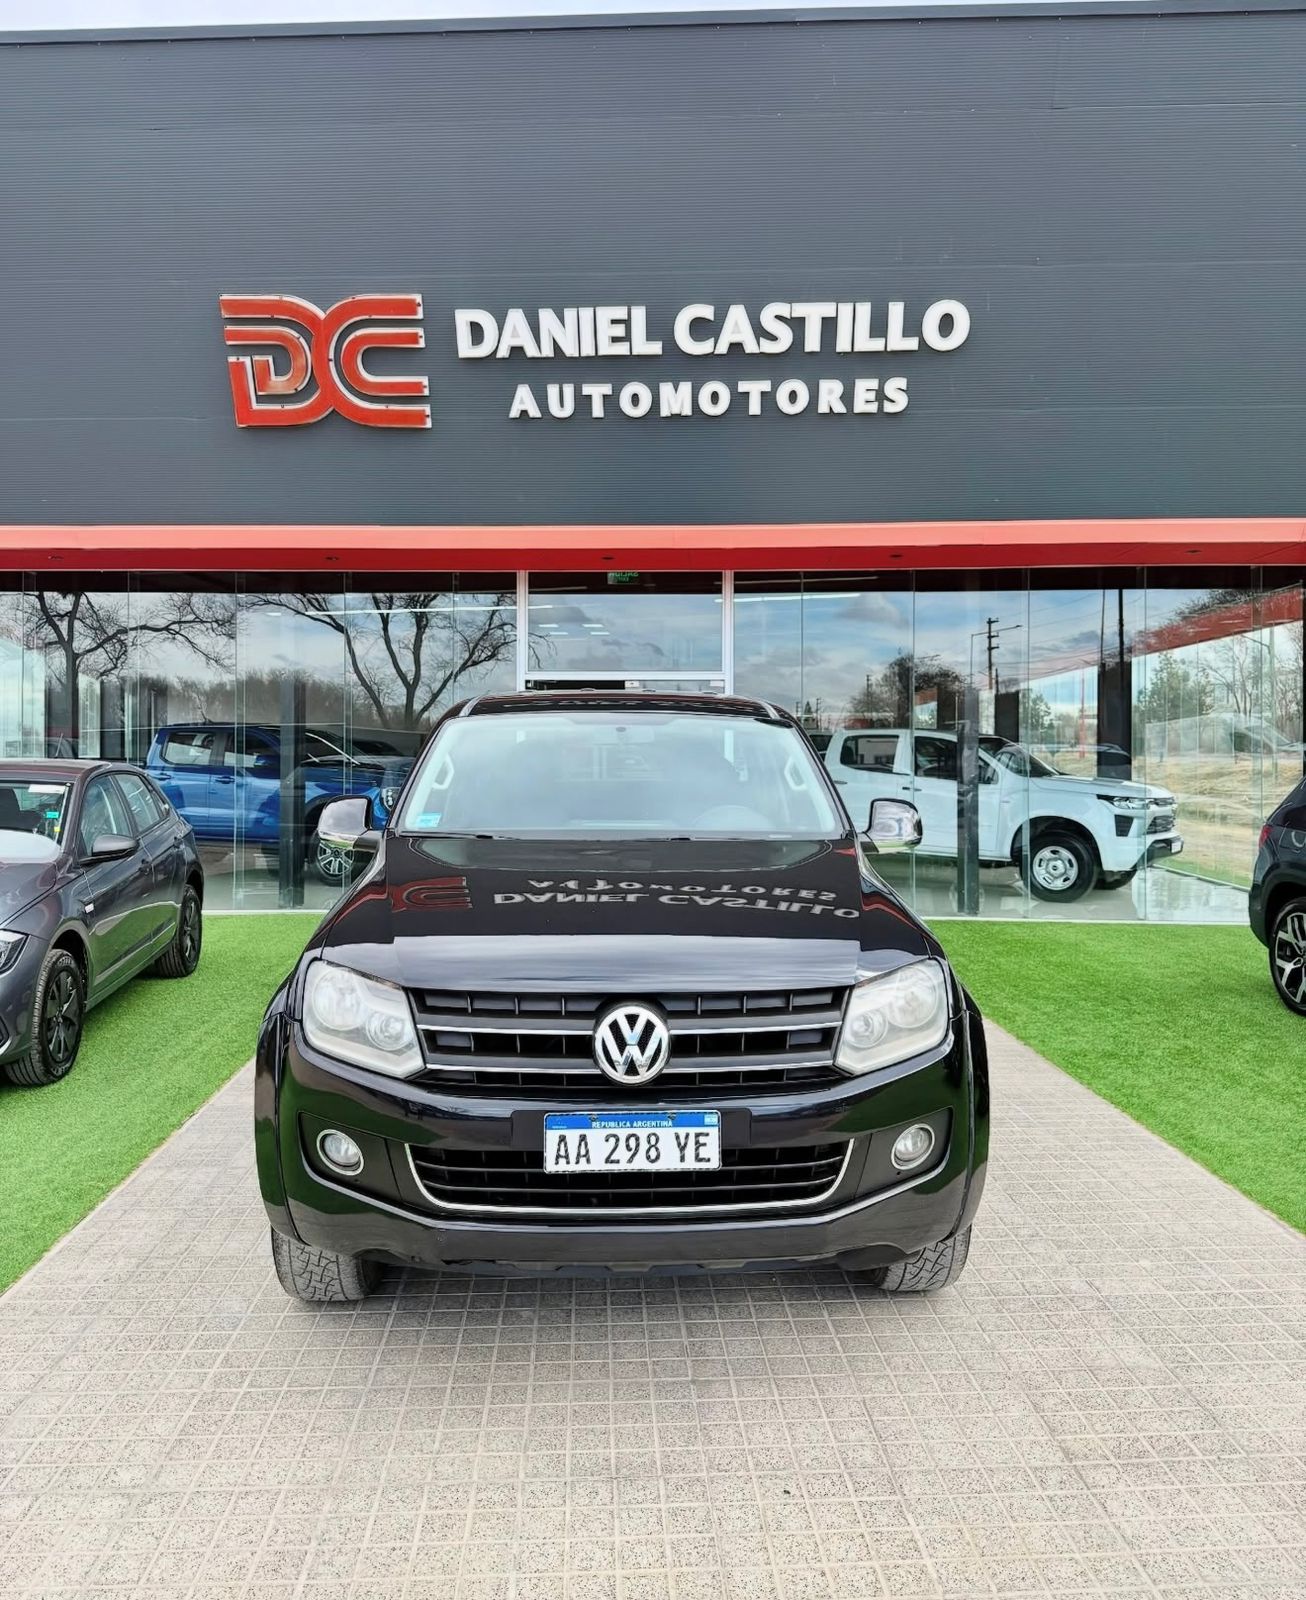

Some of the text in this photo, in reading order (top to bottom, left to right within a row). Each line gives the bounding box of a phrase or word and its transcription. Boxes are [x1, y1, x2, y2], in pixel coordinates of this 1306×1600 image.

[454, 299, 970, 359] DANIEL CASTILLO
[508, 376, 909, 419] AUTOMOTORES
[592, 1119, 673, 1129] REPUBLICA ARGENTINA
[554, 1131, 711, 1166] AA 298 YE
